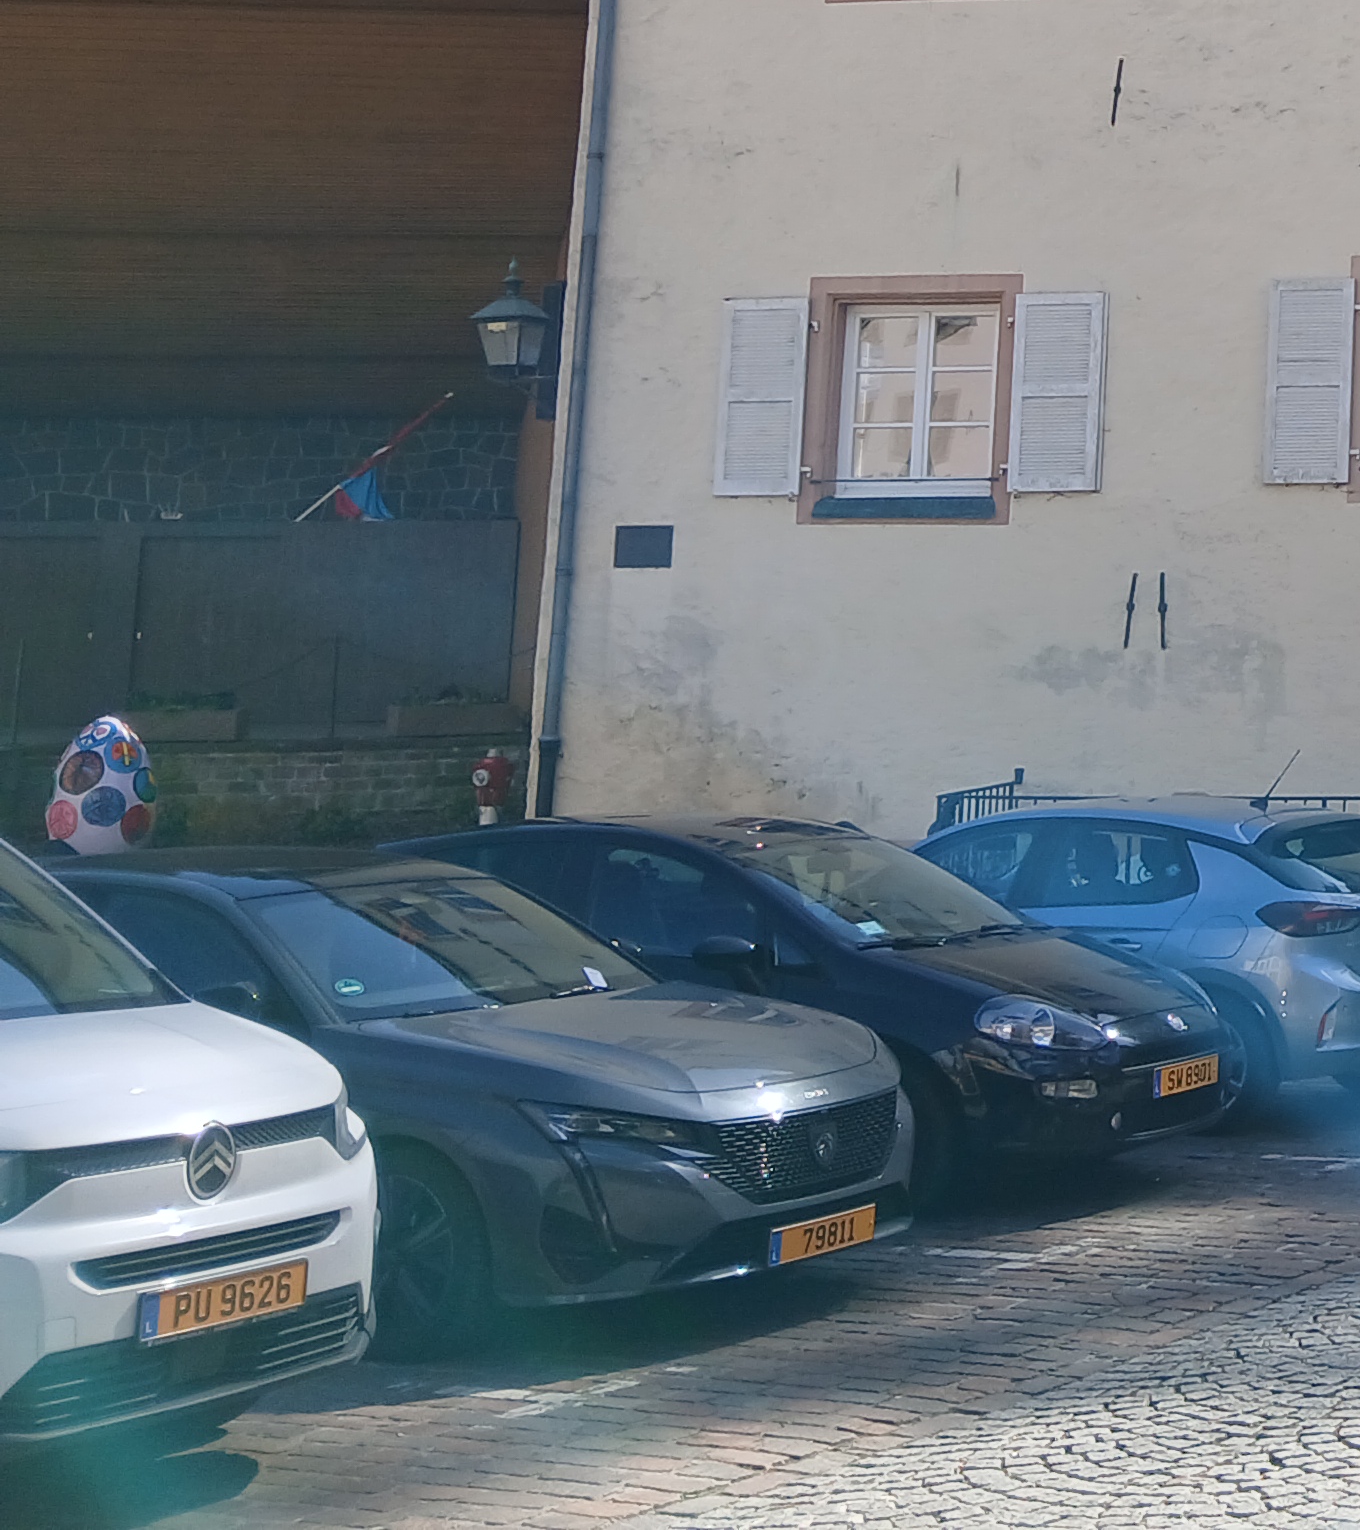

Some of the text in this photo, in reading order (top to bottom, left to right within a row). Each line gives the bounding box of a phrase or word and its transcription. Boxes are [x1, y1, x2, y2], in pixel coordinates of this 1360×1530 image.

[1167, 1061, 1212, 1091] SW 8901
[803, 1216, 855, 1254] 79811
[173, 1271, 292, 1329] PU 9626
